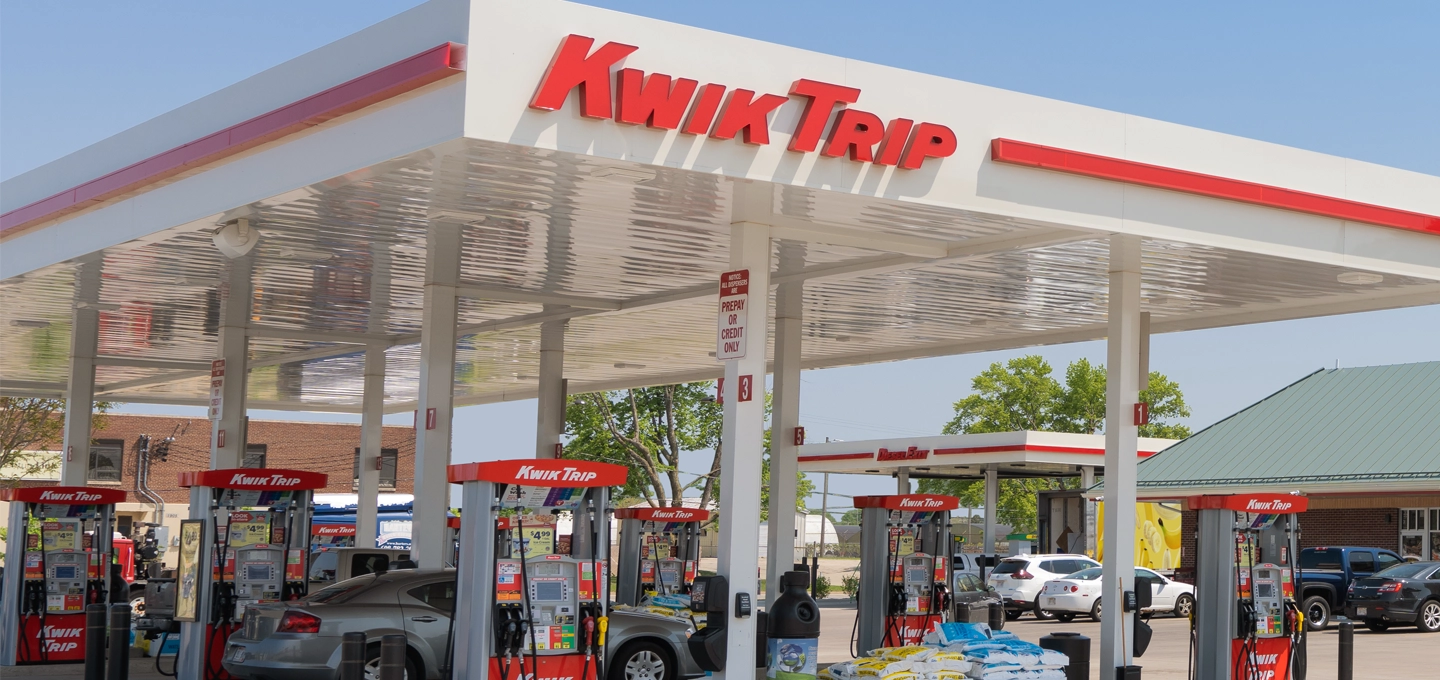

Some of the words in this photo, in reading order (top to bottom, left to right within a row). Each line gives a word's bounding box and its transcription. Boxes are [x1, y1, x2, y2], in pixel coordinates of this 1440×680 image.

[529, 33, 789, 146] KWIK
[787, 78, 957, 170] TRIP
[728, 279, 748, 288] DISPENSERS
[722, 299, 745, 312] PREPAY
[728, 314, 737, 325] OR
[722, 327, 744, 340] CREDIT
[724, 341, 740, 353] ONLY
[742, 377, 748, 400] 3
[429, 410, 434, 427] 7
[1138, 404, 1142, 424] 1
[797, 429, 802, 444] 5
[515, 466, 562, 480] KWIK
[562, 467, 597, 481] TRIP
[230, 474, 270, 485] KWIK
[270, 474, 300, 486] TRIP
[40, 491, 74, 500] KWIK
[75, 491, 102, 501] TRIP
[900, 498, 924, 507] KWIK
[923, 498, 944, 507] TRIP
[1246, 499, 1272, 510] KWIK
[1272, 500, 1292, 510] TRIP
[652, 510, 675, 518] KWIK
[36, 625, 84, 638] KWIK
[41, 640, 77, 652] TRIP
